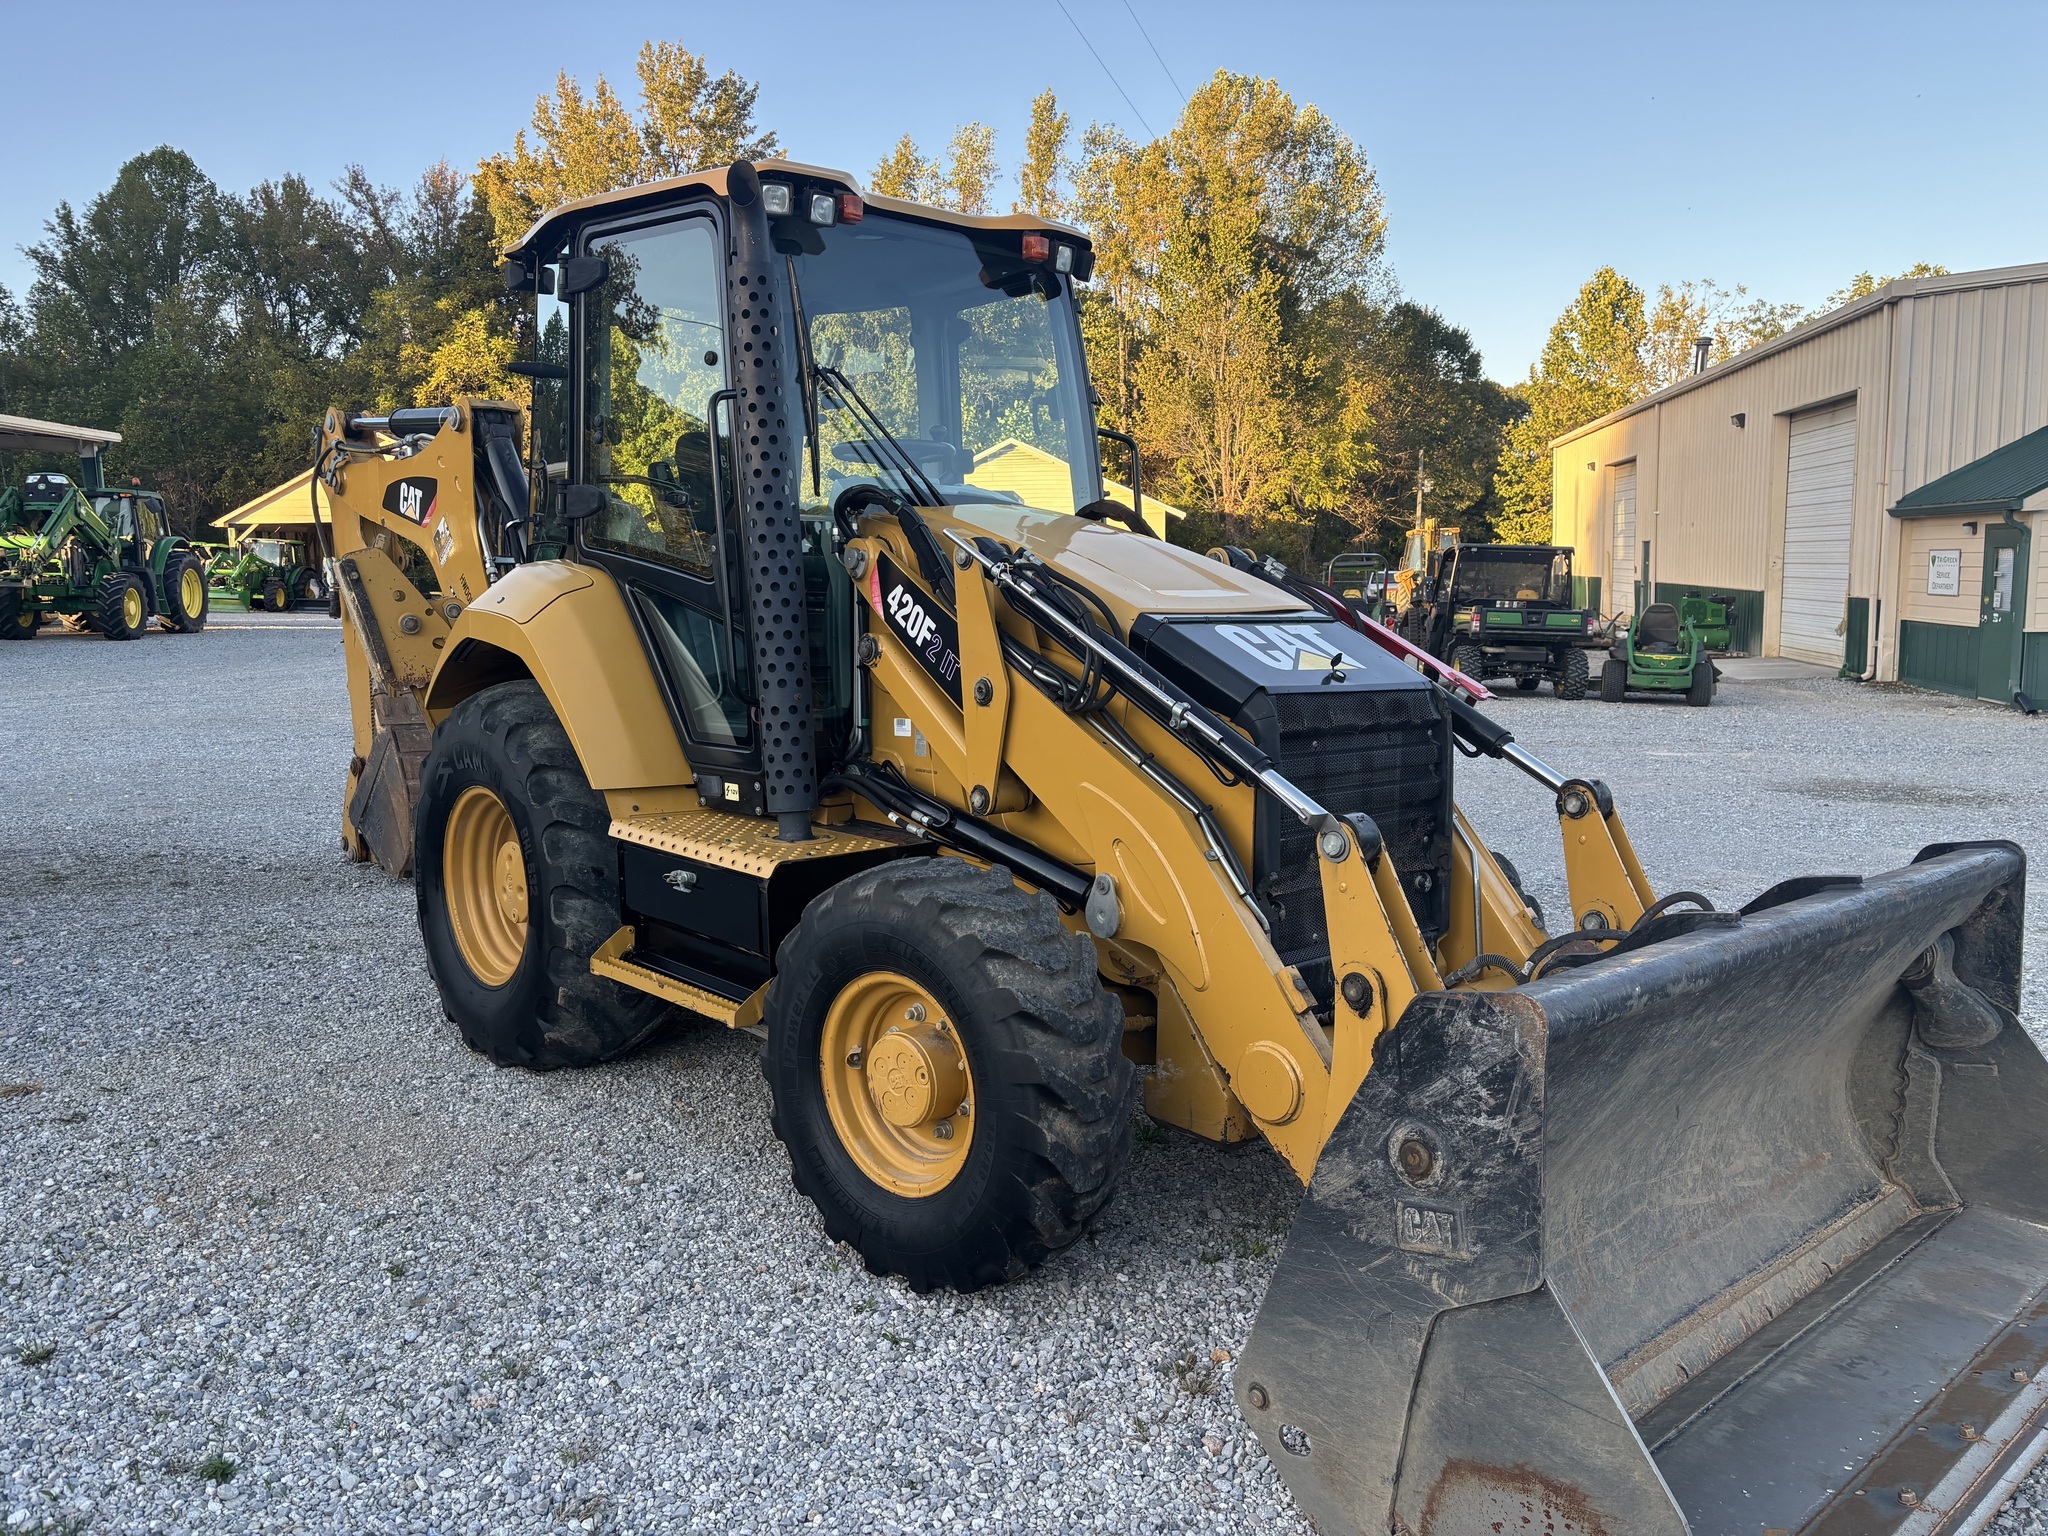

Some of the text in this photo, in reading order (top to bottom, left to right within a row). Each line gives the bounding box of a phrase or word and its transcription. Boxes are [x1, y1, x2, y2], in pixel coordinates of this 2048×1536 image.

[400, 482, 422, 521] CAT
[1215, 625, 1367, 671] CAT
[520, 826, 539, 896] BHL 532
[1403, 1207, 1454, 1250] CAT
